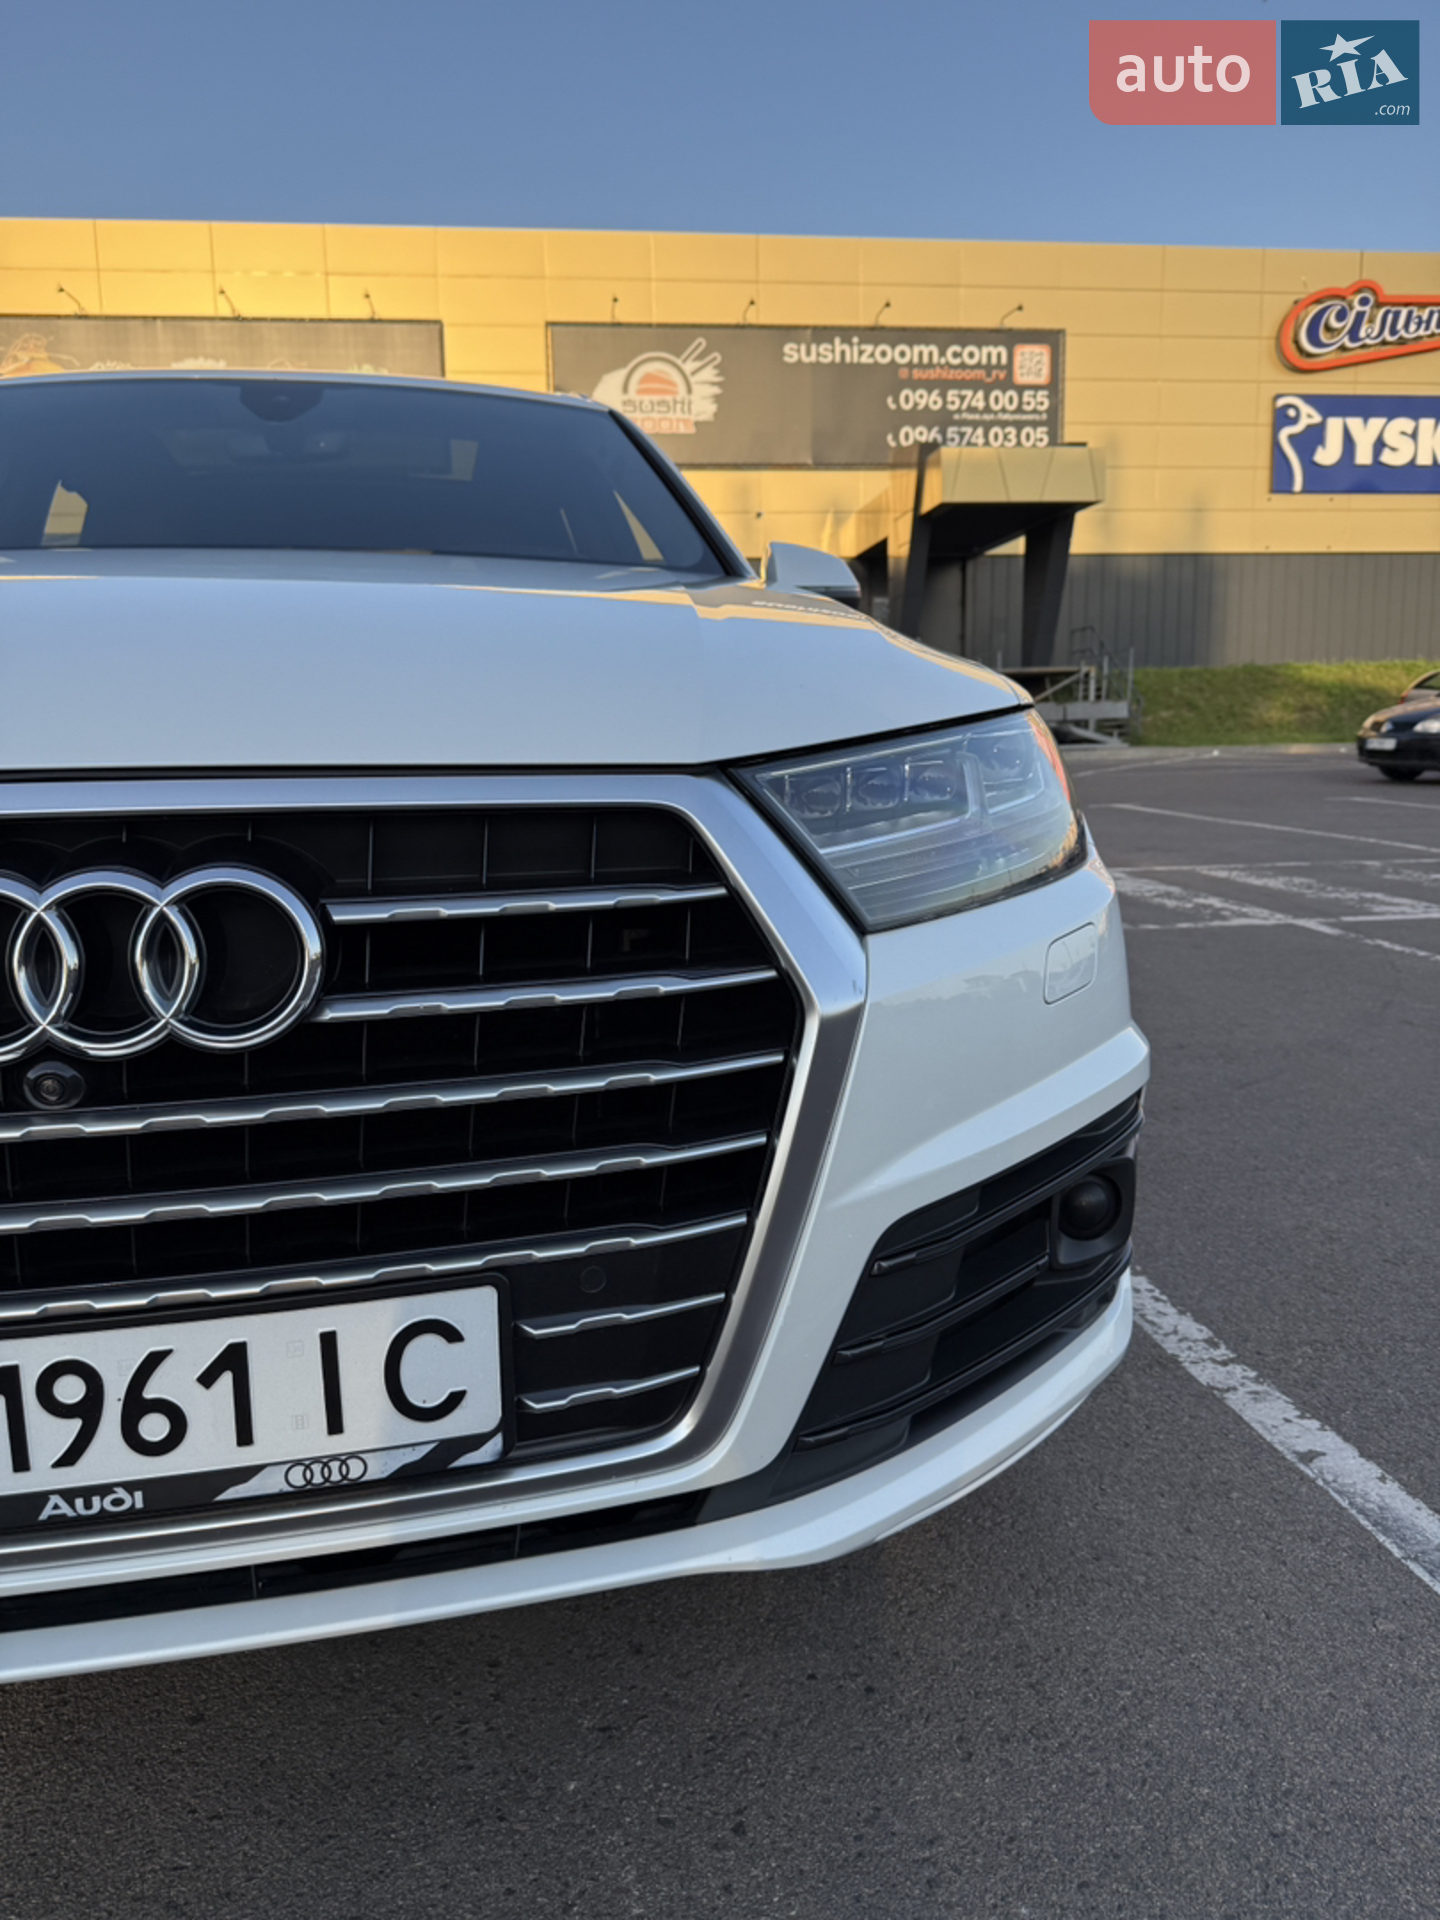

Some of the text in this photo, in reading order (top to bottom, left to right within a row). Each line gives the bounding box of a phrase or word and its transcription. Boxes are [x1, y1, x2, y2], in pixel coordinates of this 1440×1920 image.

[782, 337, 1007, 365] sushizoom.com
[899, 388, 1050, 411] 096 574 00 55
[946, 426, 986, 447] 574
[988, 426, 1018, 448] 03
[1020, 426, 1050, 448] 05
[1312, 416, 1440, 467] JYSK
[0, 1315, 469, 1474] 1961 IC
[38, 1486, 145, 1522] Audi
